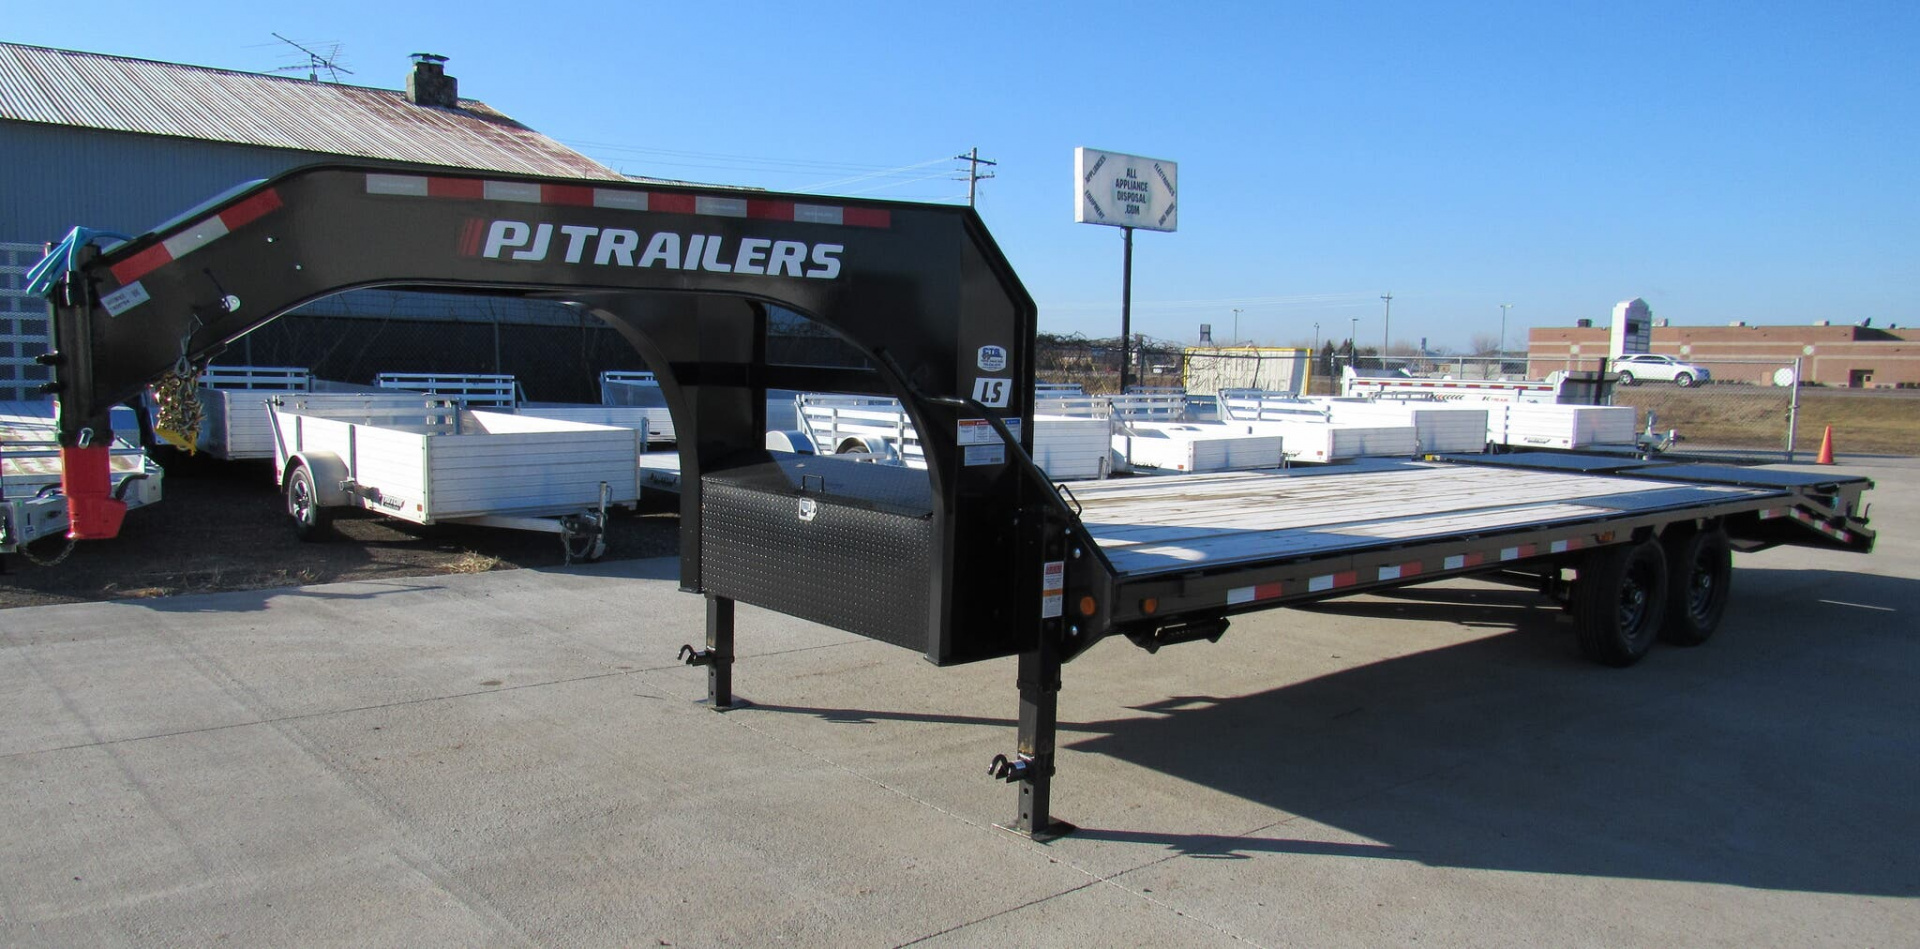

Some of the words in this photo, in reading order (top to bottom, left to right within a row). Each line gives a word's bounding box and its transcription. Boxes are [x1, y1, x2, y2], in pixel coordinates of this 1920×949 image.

[1126, 168, 1138, 179] ALL
[1154, 162, 1175, 197] ELECTRONICS
[1115, 178, 1148, 192] APPLIANCE
[1085, 189, 1105, 219] EQUIPMENT
[1116, 191, 1146, 204] DISPOSAL
[1125, 204, 1140, 215] .COM
[483, 220, 554, 262] PJ
[561, 224, 844, 280] TRAILERS
[980, 381, 1003, 403] LS
